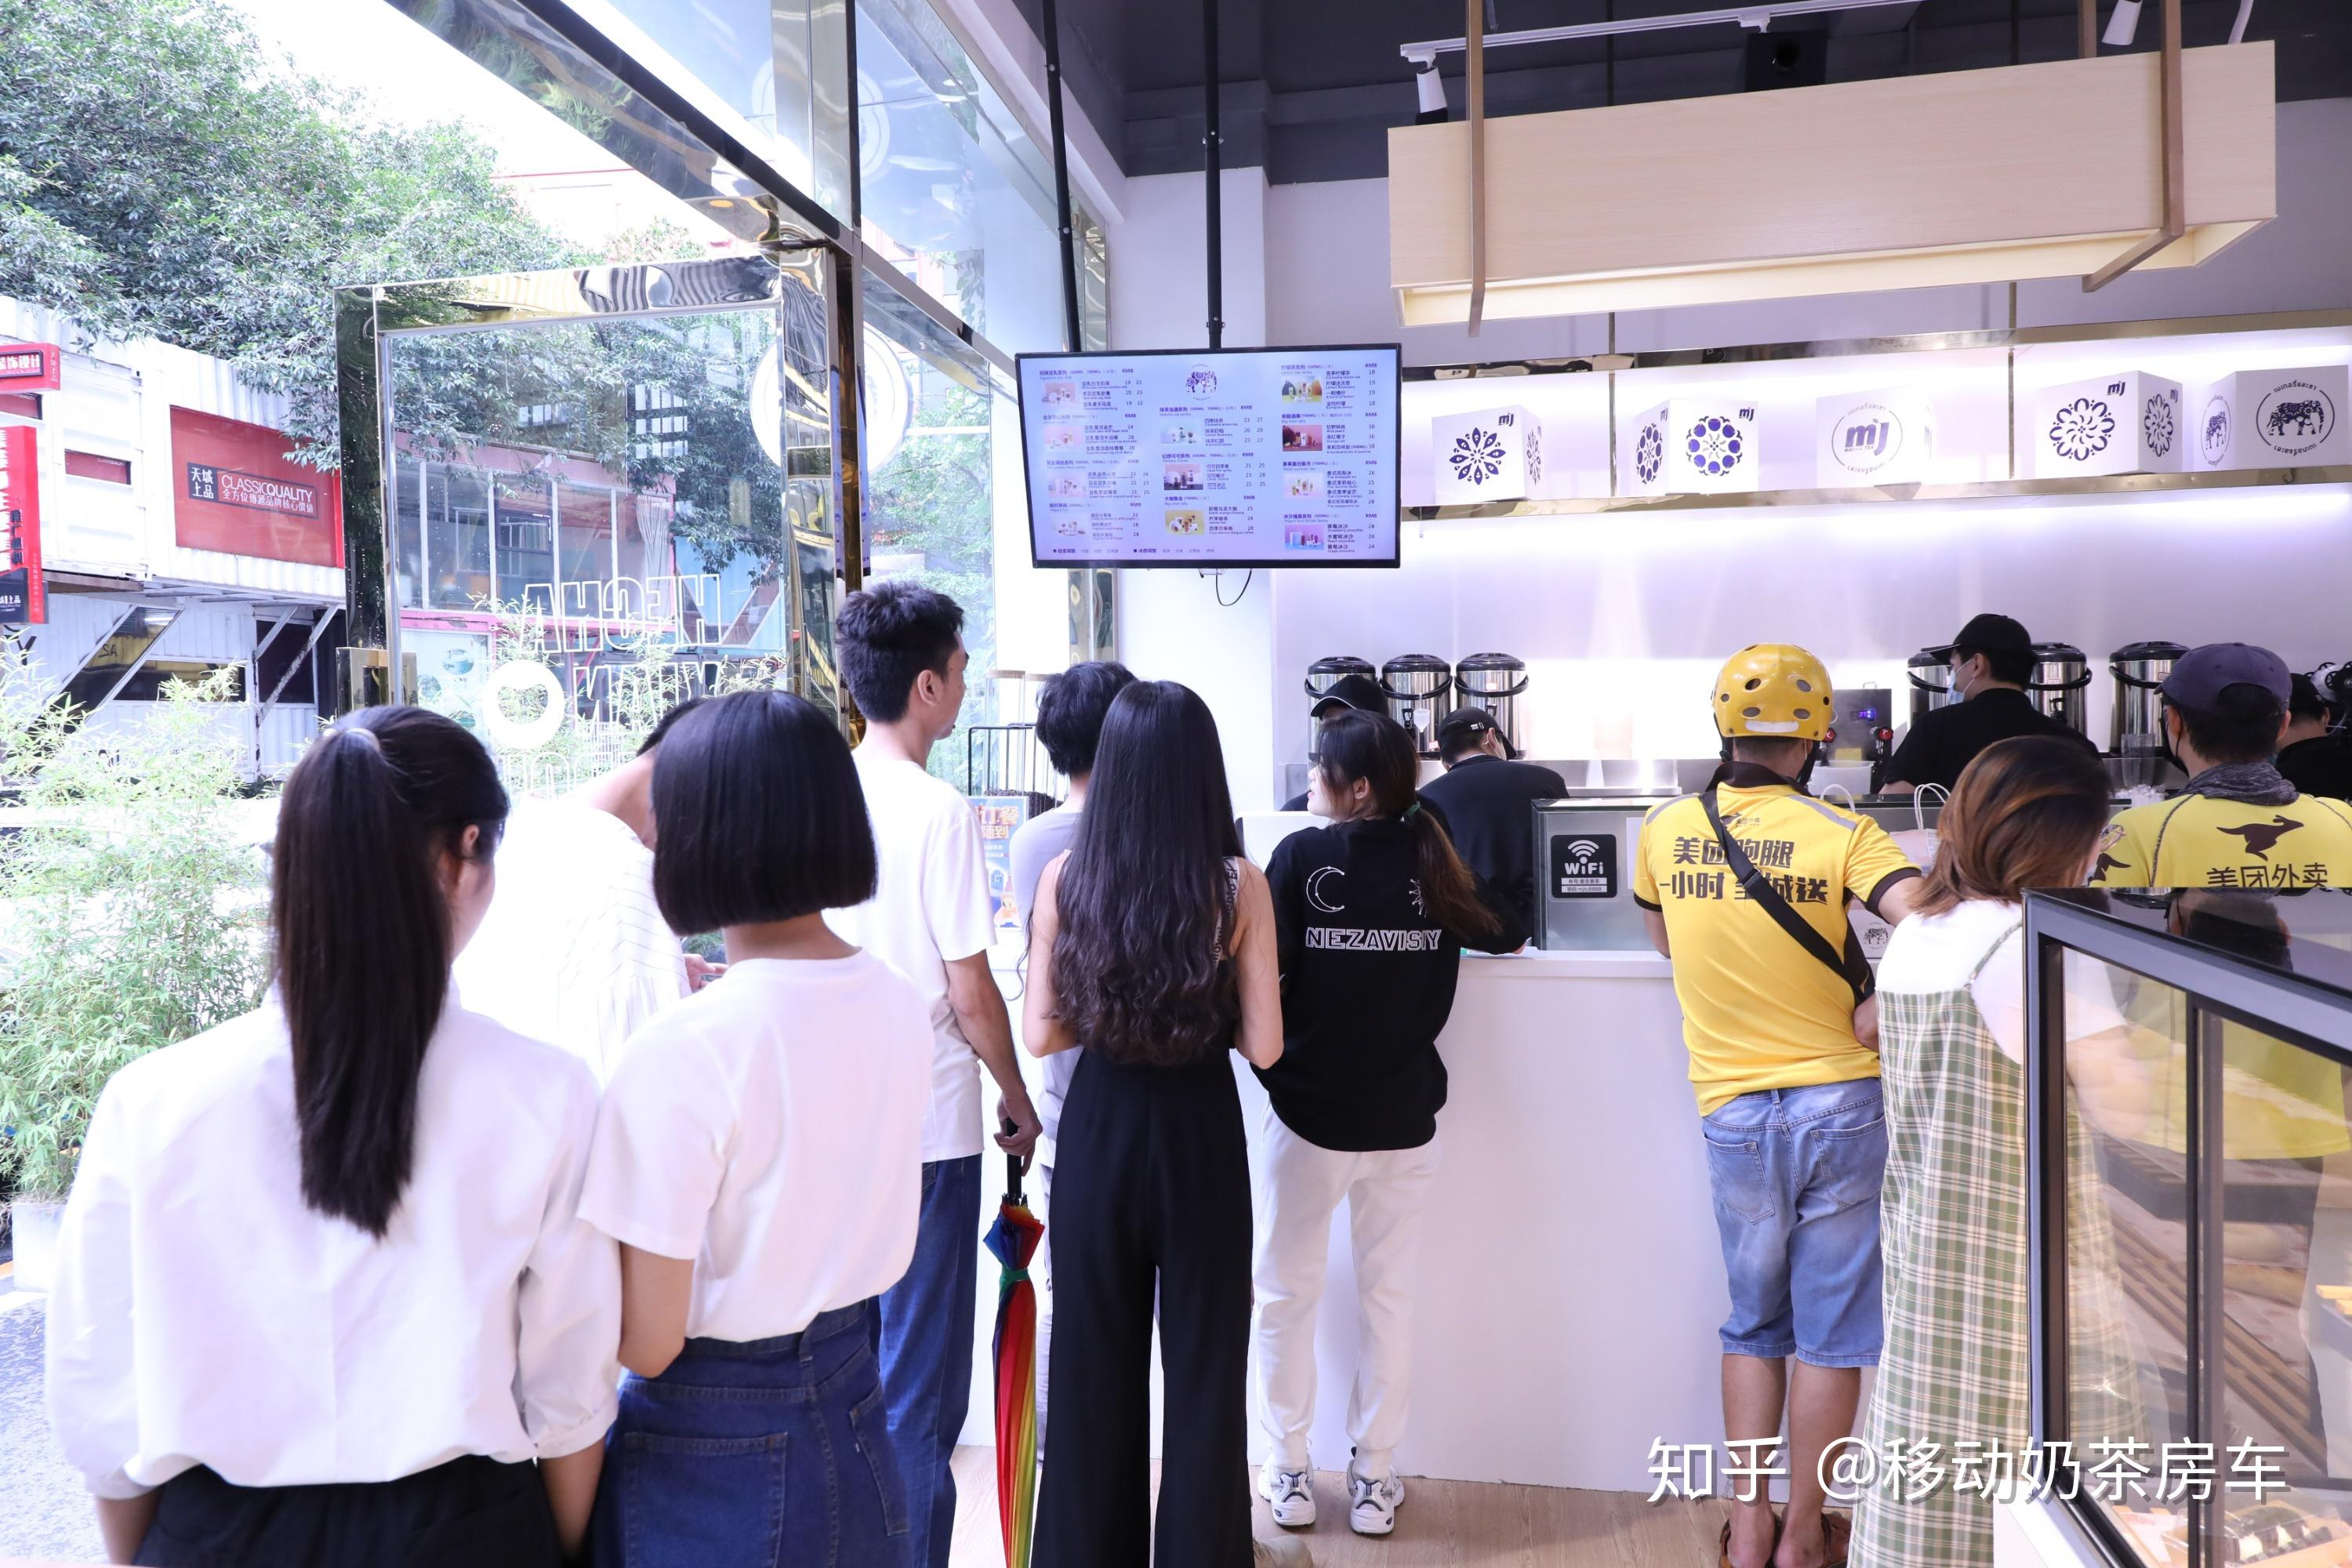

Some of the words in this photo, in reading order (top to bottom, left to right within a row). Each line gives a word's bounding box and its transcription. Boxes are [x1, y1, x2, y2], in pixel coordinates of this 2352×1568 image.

[1564, 862, 1603, 875] WiFi
[2206, 863, 2328, 887] 美团外卖
